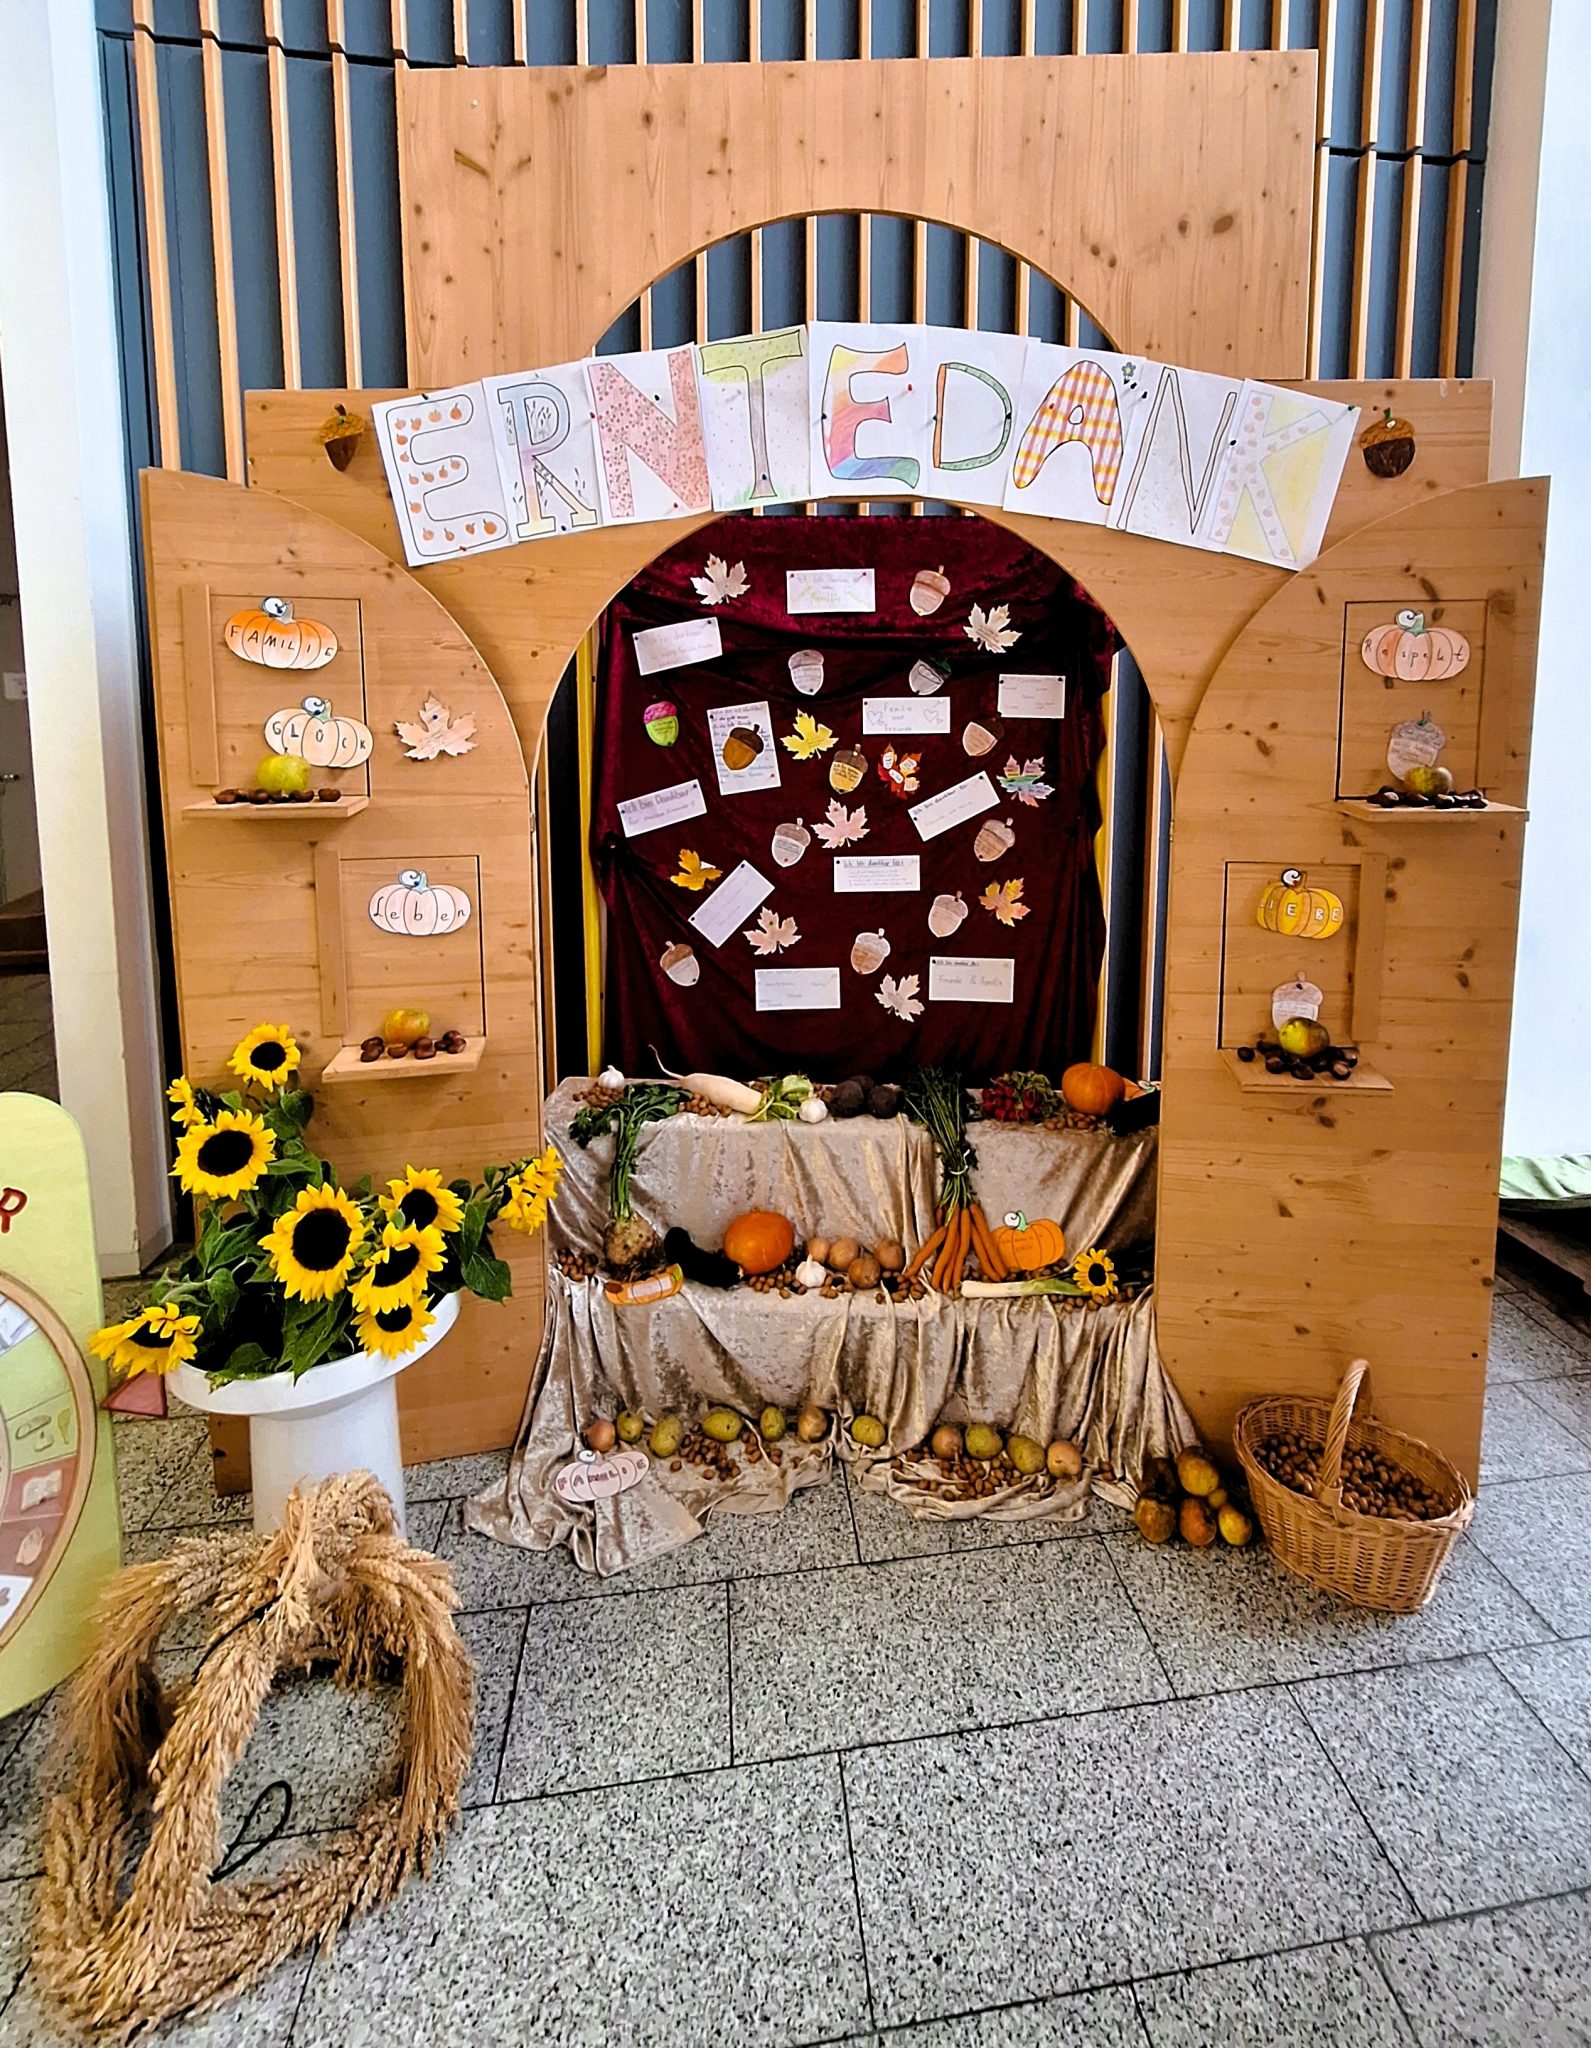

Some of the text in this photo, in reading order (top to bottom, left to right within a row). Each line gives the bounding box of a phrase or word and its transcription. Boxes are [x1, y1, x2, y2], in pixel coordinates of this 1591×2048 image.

[386, 330, 1332, 562] ERNTEDANK
[230, 625, 334, 656] FAMILIE
[1364, 638, 1464, 668] Respekt
[373, 896, 466, 921] Leben
